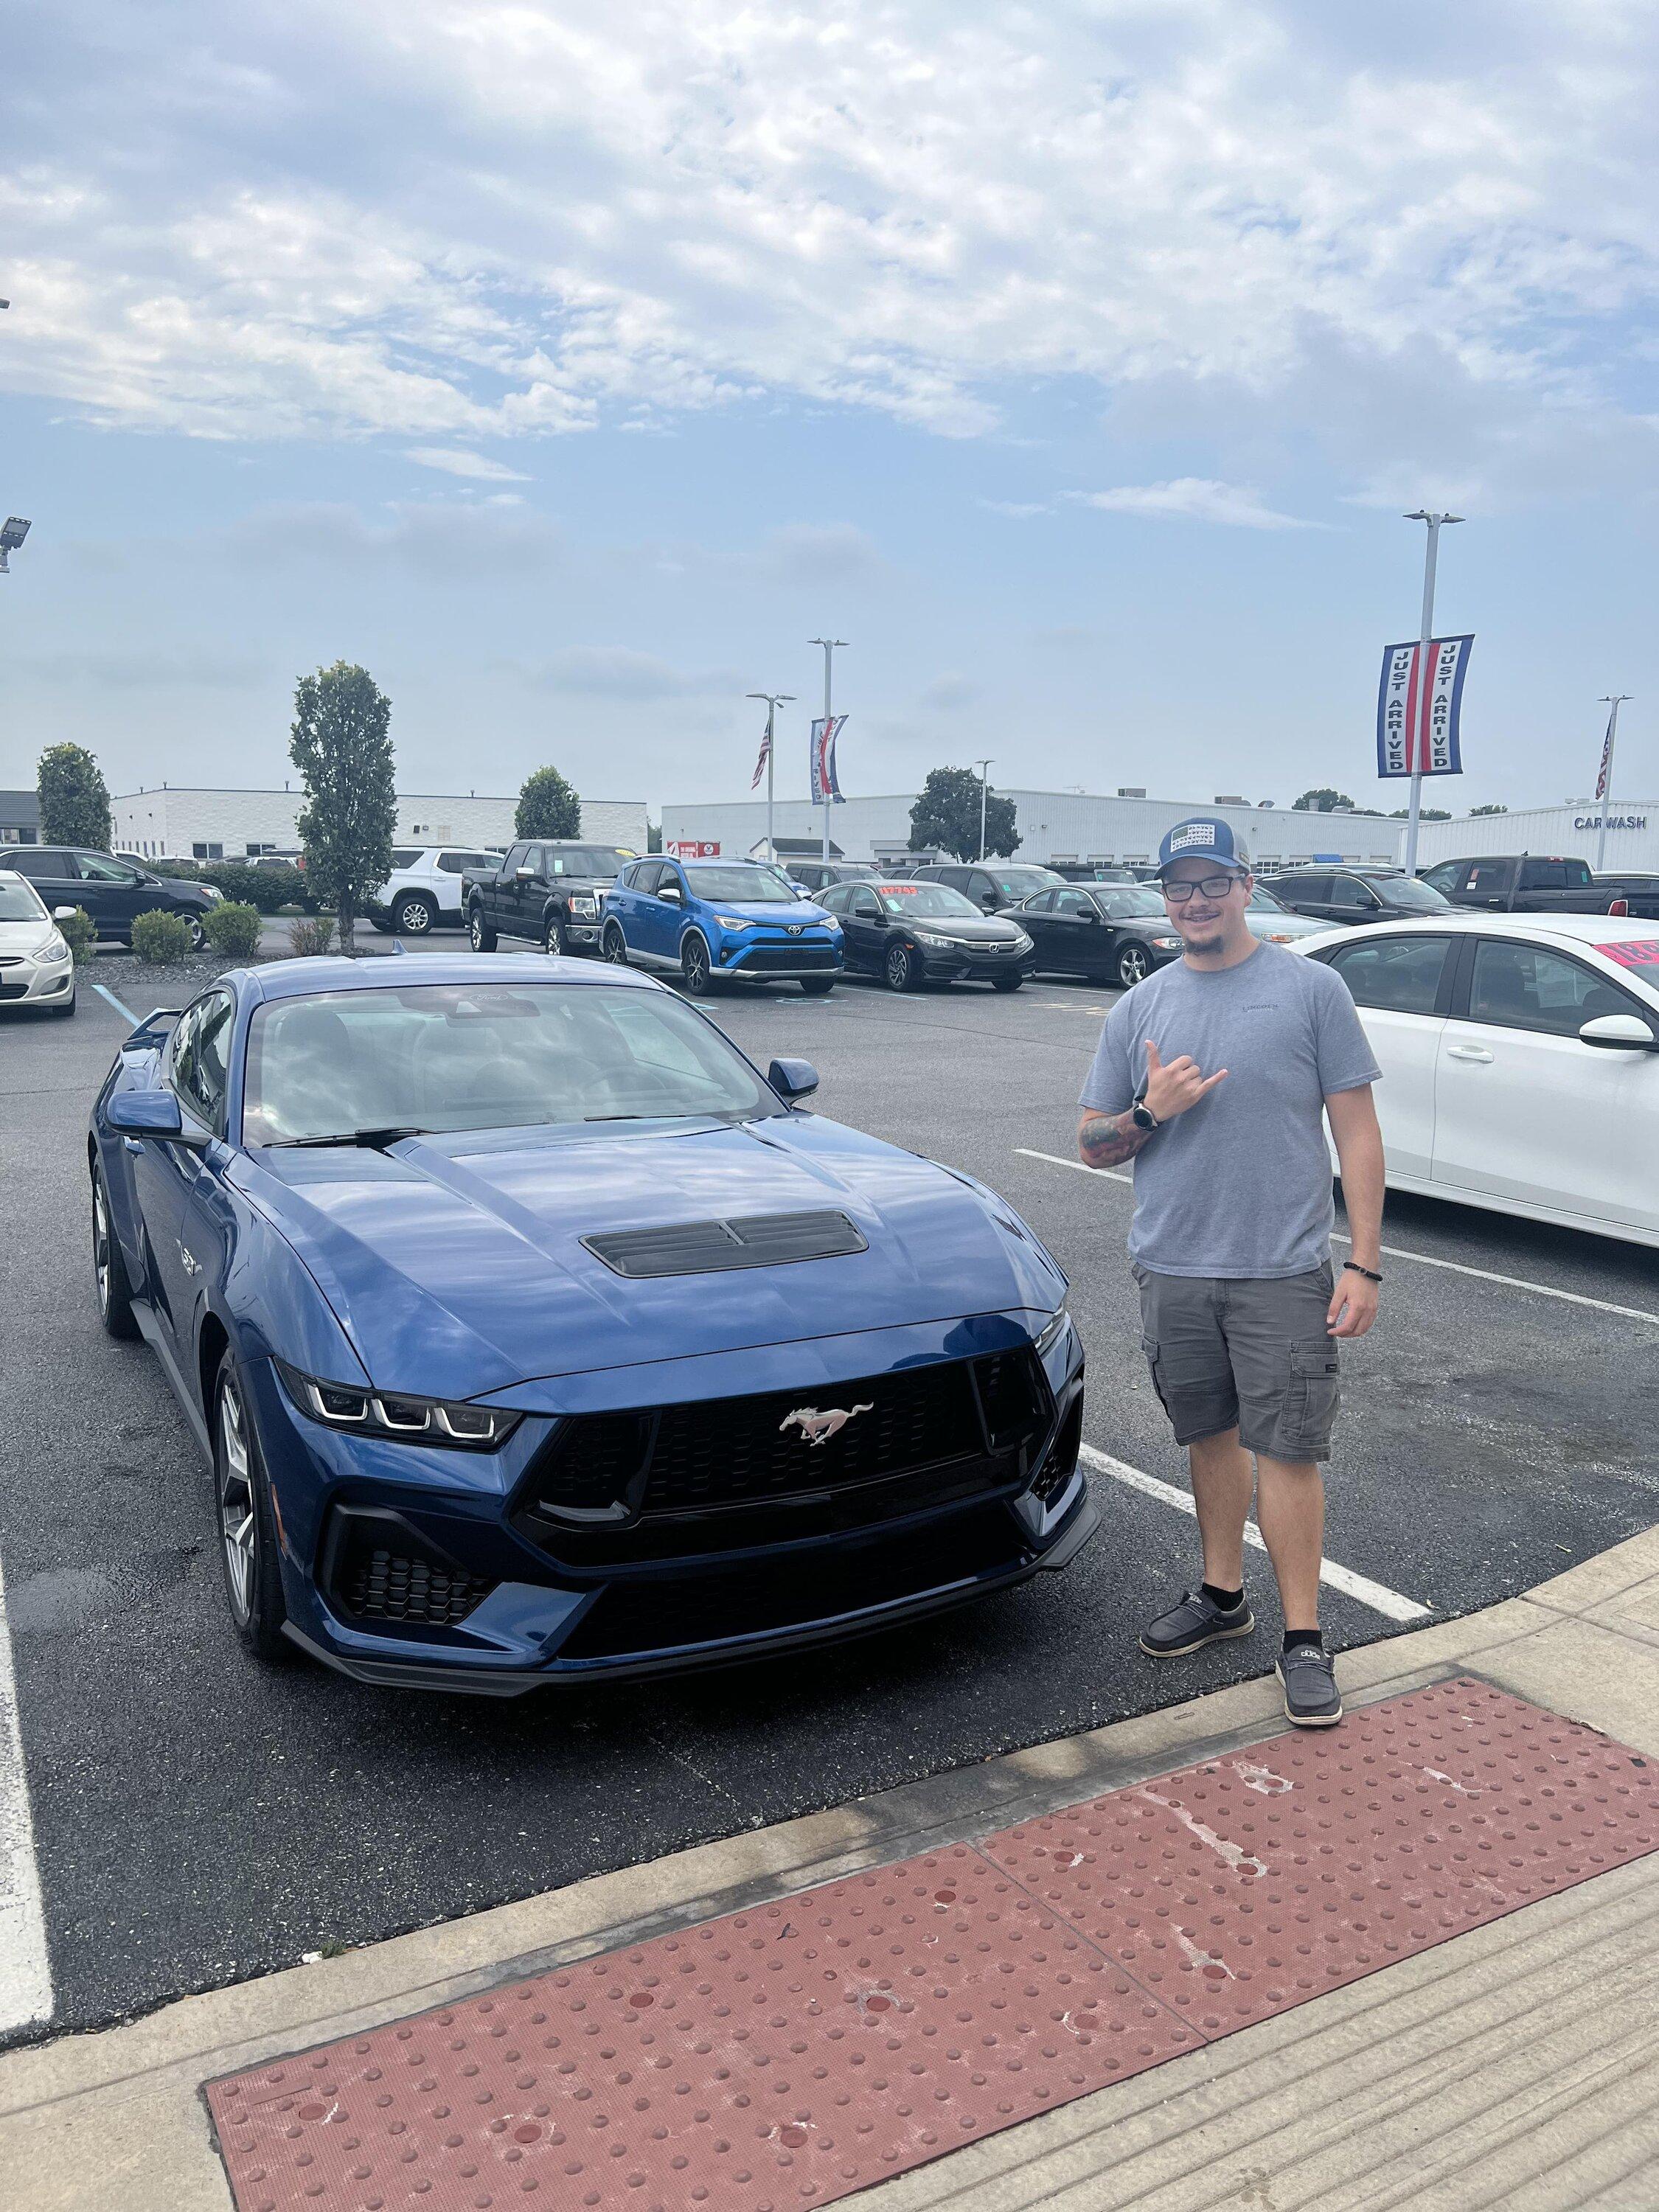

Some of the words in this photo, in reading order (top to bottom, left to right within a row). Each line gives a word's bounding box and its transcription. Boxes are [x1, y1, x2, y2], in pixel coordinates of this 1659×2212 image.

[1391, 651, 1409, 691] JUST
[1438, 644, 1456, 686] JUST
[1388, 700, 1404, 770] ARRIVED
[1433, 695, 1448, 768] ARRIVED
[1574, 817, 1602, 830] CAR
[1606, 816, 1647, 830] WASH
